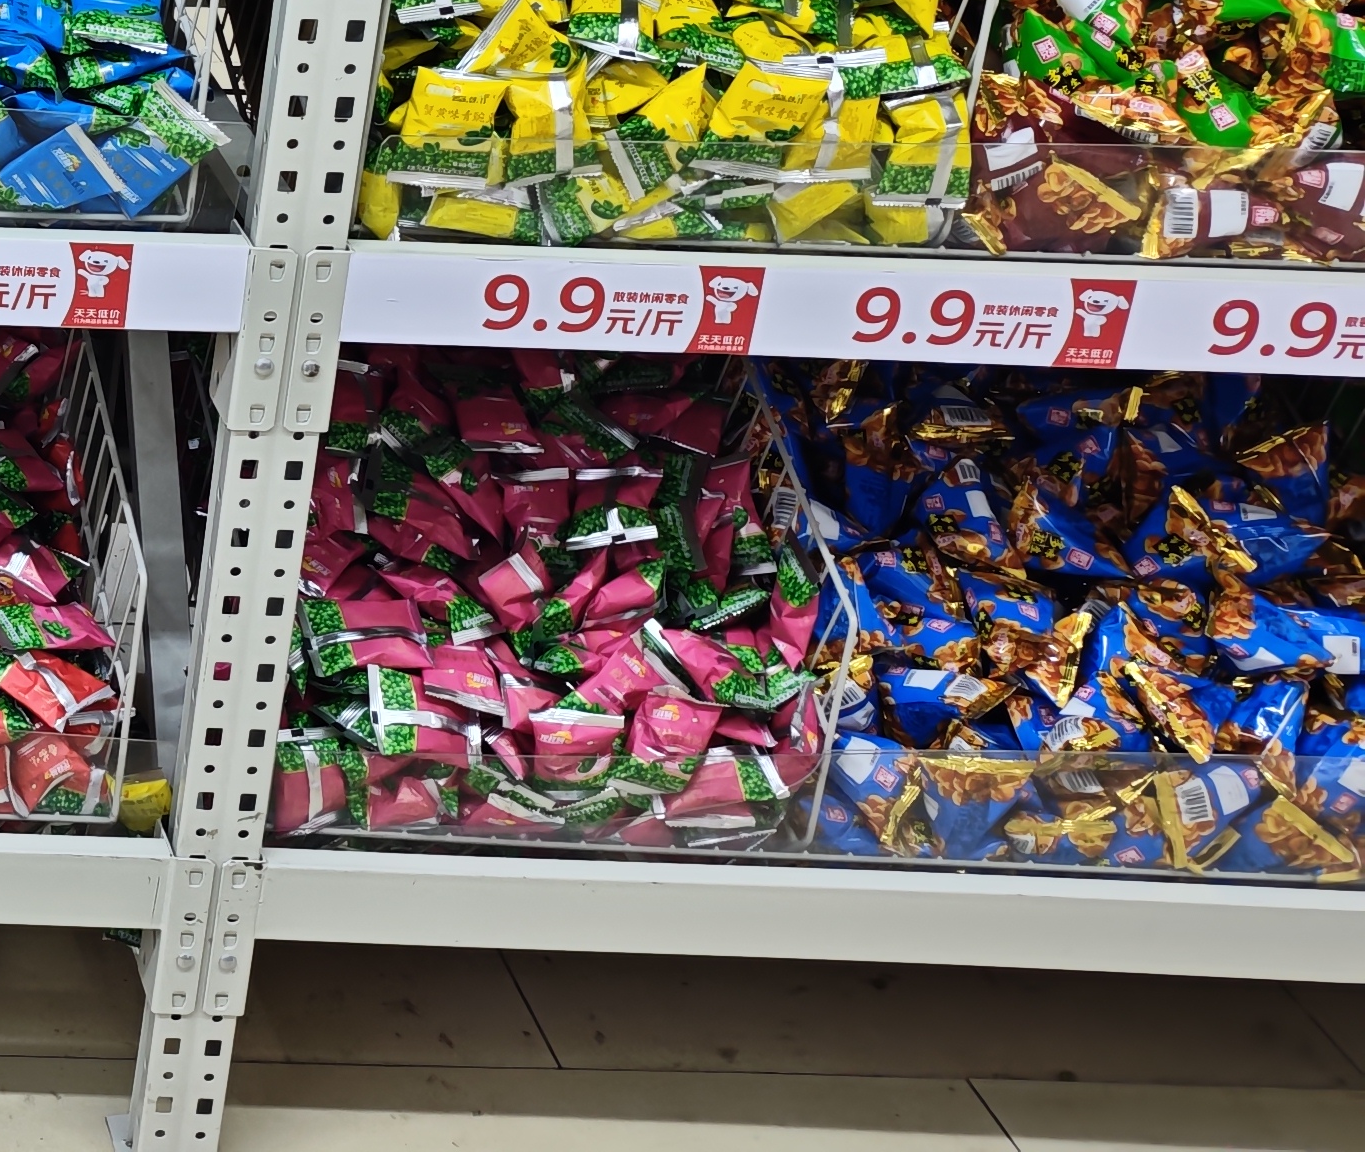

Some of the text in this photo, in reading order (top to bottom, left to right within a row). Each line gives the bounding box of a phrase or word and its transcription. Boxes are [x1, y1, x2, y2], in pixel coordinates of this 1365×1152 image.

[484, 275, 605, 332] 9.9
[612, 291, 690, 305] 散装休闲零食
[72, 309, 121, 319] 天天低价
[605, 309, 683, 336] 元/斤
[854, 287, 975, 345] 9.9
[982, 304, 1060, 318] 散装休闲零食
[697, 335, 746, 345] 天天低价
[973, 322, 1052, 349] 元/斤
[1209, 300, 1336, 357] 9.9
[1065, 348, 1114, 358] 天天低价
[1333, 334, 1365, 359] 元
